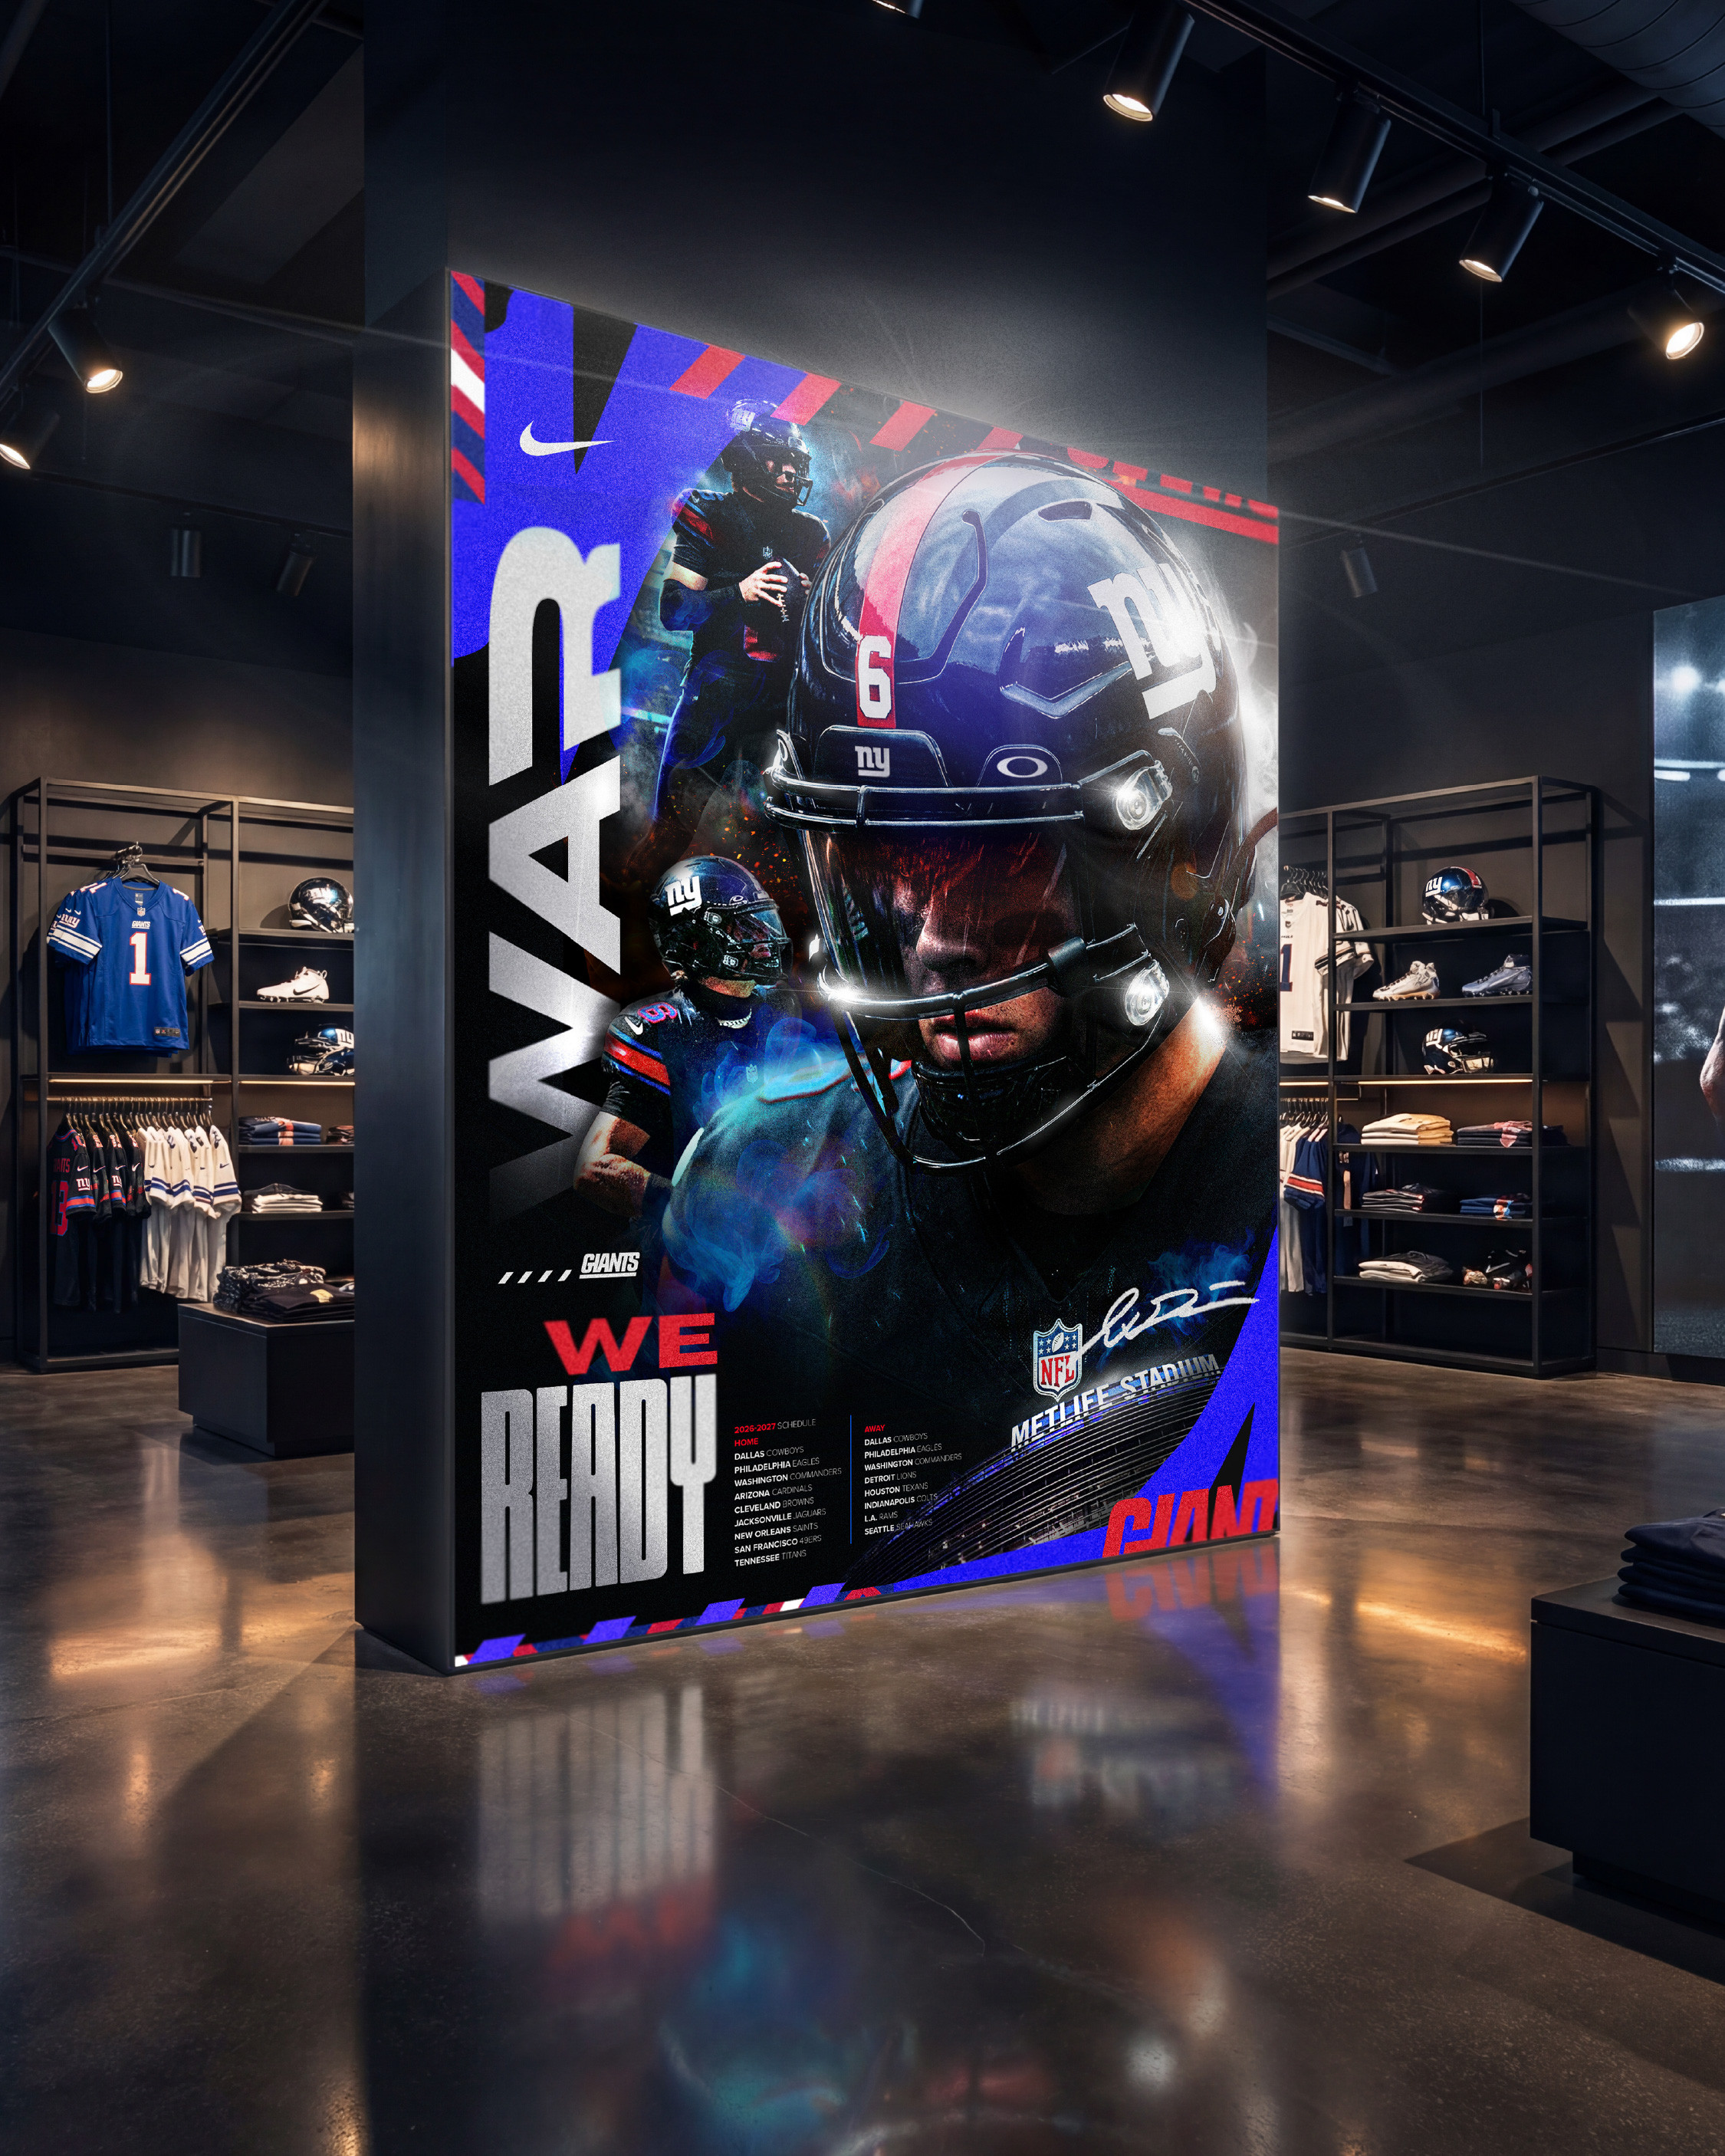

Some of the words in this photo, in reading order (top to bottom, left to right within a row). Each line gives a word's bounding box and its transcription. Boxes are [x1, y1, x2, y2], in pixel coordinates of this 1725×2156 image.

[858, 635, 892, 719] 6
[855, 746, 890, 777] ny
[488, 527, 621, 1221] WAR
[1425, 876, 1443, 898] ny
[665, 876, 702, 916] ny
[131, 920, 151, 929] GIANTS
[130, 932, 151, 985] 1
[76, 1178, 90, 1191] ny
[580, 1251, 641, 1277] GIANTS
[543, 1313, 718, 1375] WE
[1040, 1354, 1075, 1389] NFL
[1010, 1383, 1110, 1453] METLIFE
[1119, 1353, 1221, 1401] STADIUM
[734, 1423, 776, 1433] 2026-2027
[777, 1418, 816, 1429] SCHEDULE
[734, 1438, 758, 1447] HOME
[865, 1437, 892, 1445] DALLAS
[893, 1432, 928, 1443] COWBOYS
[734, 1451, 764, 1460] DALLAS
[766, 1447, 804, 1457] COWBOYS
[865, 1447, 915, 1458] PHILADELPHIA
[917, 1443, 942, 1453] EAGLES
[734, 1461, 790, 1474] PHILADELPHIA
[792, 1457, 820, 1467] EAGLES
[865, 1459, 912, 1471] WASHINGTON
[914, 1453, 962, 1465] COMMANDERS
[734, 1474, 787, 1487] WASHINGTON
[790, 1467, 842, 1480] COMMANDERS
[865, 1474, 895, 1484] DETROIT
[896, 1471, 917, 1481] LIONS
[481, 1373, 717, 1605] READY
[734, 1490, 770, 1500] ARIZONA
[771, 1484, 813, 1496] CARDINALS
[865, 1486, 899, 1497] HOUSTON
[902, 1482, 928, 1492] TEXANS
[734, 1501, 780, 1513] CLEVELAND
[782, 1497, 814, 1508] BROWNS
[865, 1497, 915, 1509] INDIANAPOLIS
[916, 1493, 938, 1502] COLTS
[734, 1513, 791, 1527] JACKSONVILLE
[793, 1508, 826, 1519] JAGUARS
[879, 1510, 899, 1520] RAMS
[755, 1527, 790, 1537] ORLEANS
[792, 1522, 819, 1533] SAINTS
[865, 1525, 894, 1535] SEATTLE
[896, 1519, 932, 1531] SEAHAWKS
[735, 1545, 751, 1553] SAN
[754, 1539, 797, 1550] FRANCISCO
[799, 1534, 822, 1544] 49ERS
[734, 1554, 779, 1566] TENNESSEE
[781, 1550, 807, 1559] TITANS
